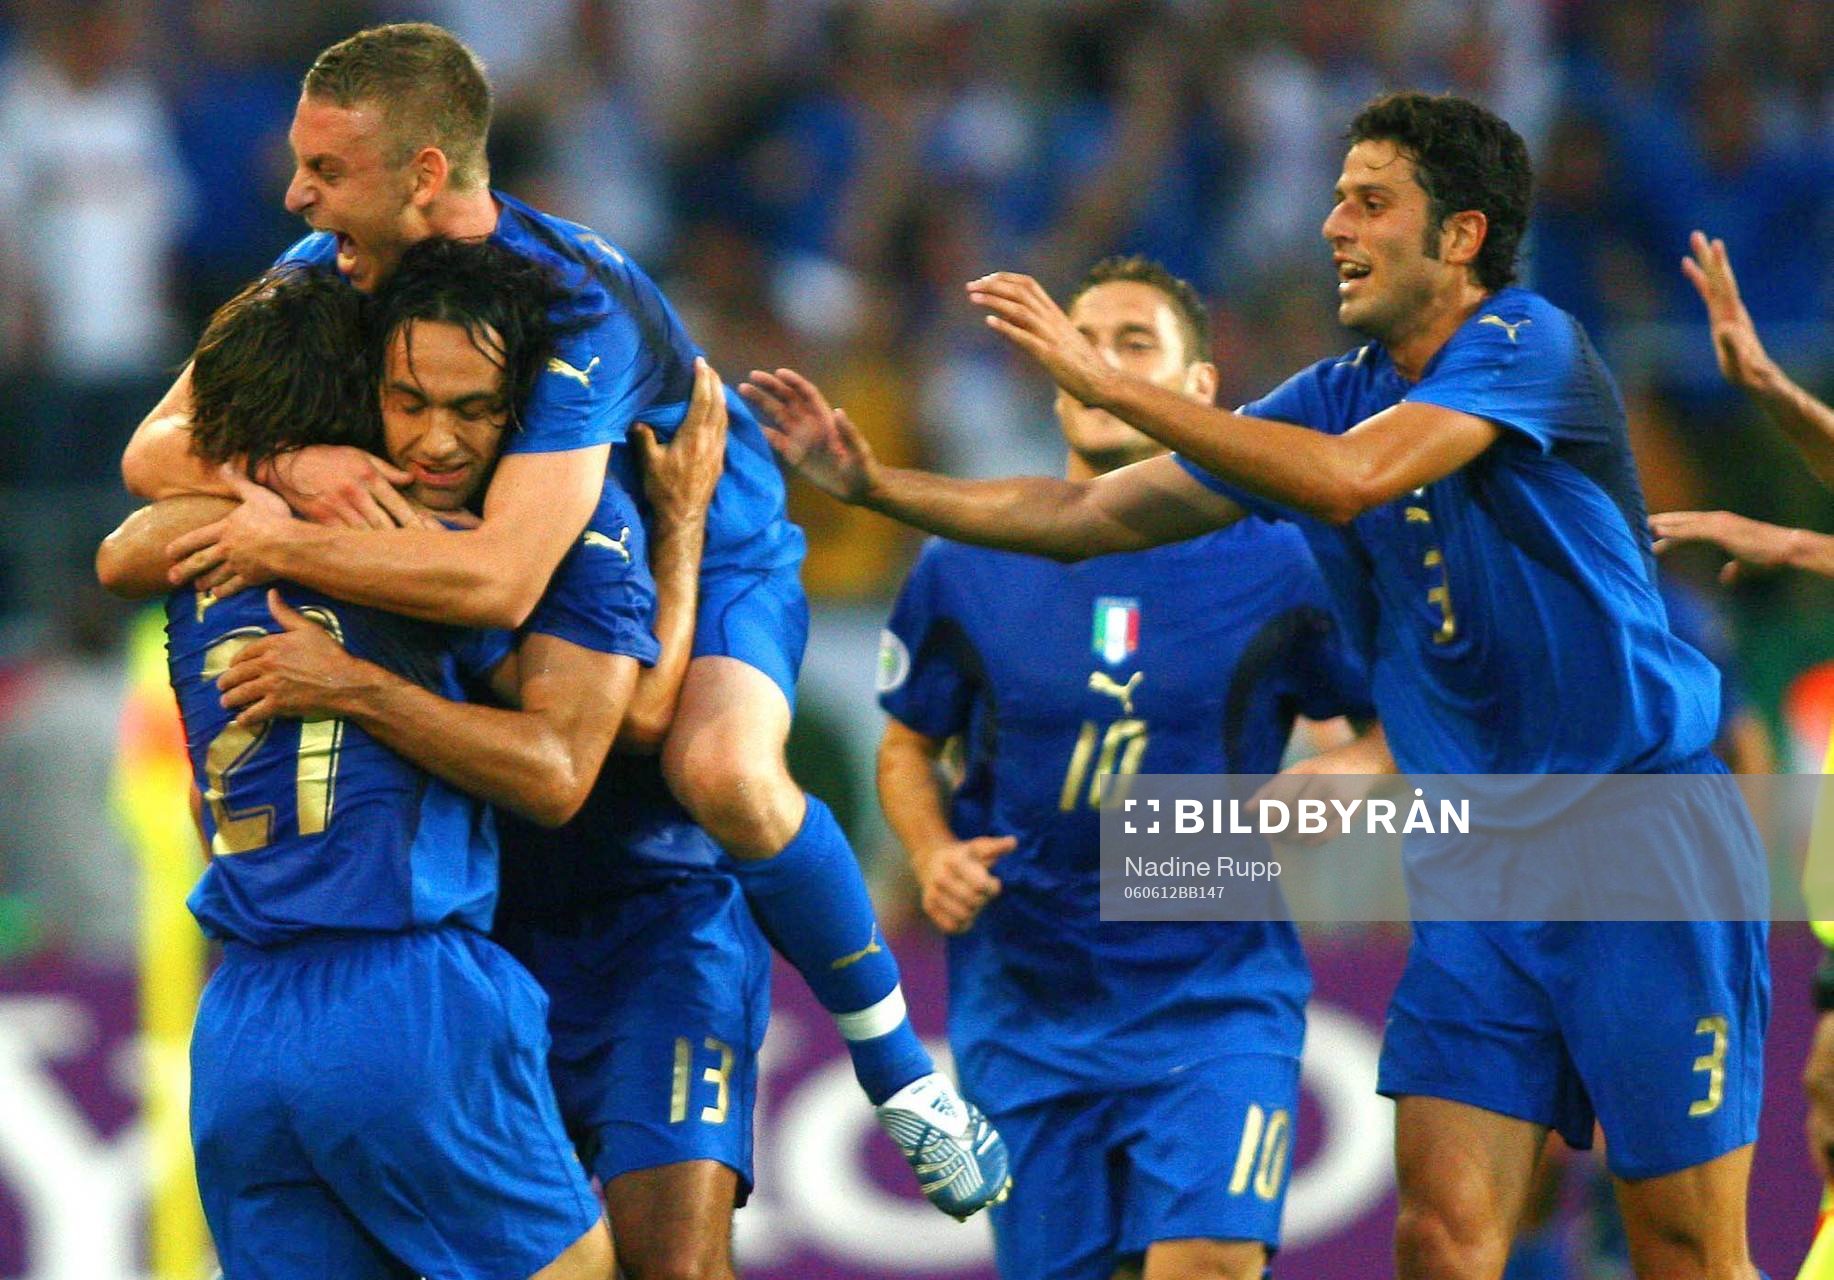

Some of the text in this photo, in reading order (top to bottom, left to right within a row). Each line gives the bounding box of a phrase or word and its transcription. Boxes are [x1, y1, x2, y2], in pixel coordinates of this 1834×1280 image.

[1423, 549, 1456, 645] 3
[1060, 719, 1147, 811] 10
[669, 1035, 734, 1124] 13
[1687, 1015, 1727, 1117] 3
[1227, 1103, 1289, 1200] 10
